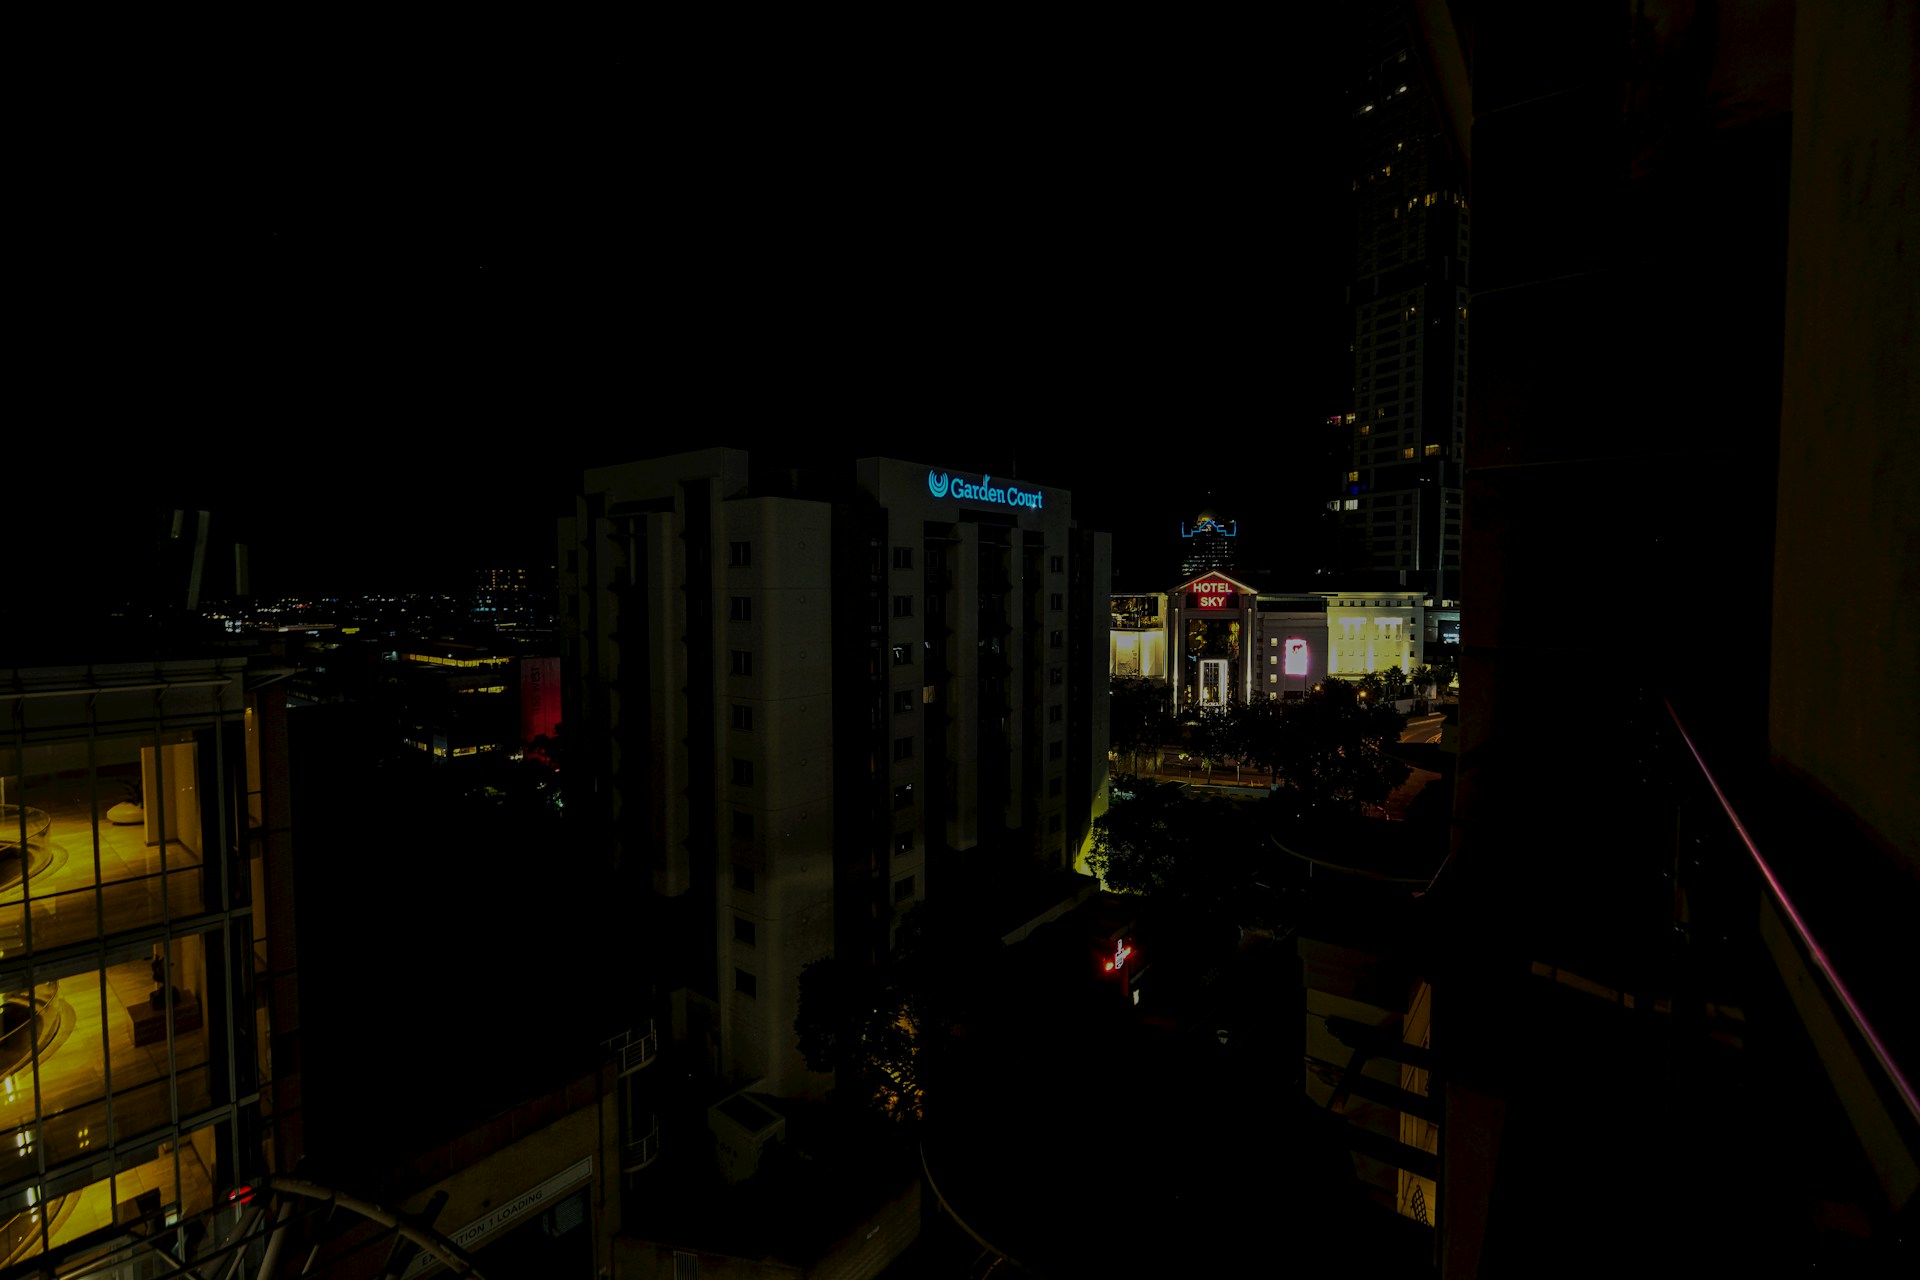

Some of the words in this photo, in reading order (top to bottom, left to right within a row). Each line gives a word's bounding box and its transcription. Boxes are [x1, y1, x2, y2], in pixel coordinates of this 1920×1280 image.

[951, 474, 1005, 503] Garden
[1007, 487, 1043, 509] Court
[1193, 582, 1233, 593] HOTEL
[1200, 596, 1225, 607] SKY
[530, 667, 541, 693] WEST
[422, 1223, 485, 1266] EXITION
[489, 1218, 494, 1227] 1
[497, 1190, 543, 1222] LOADING
